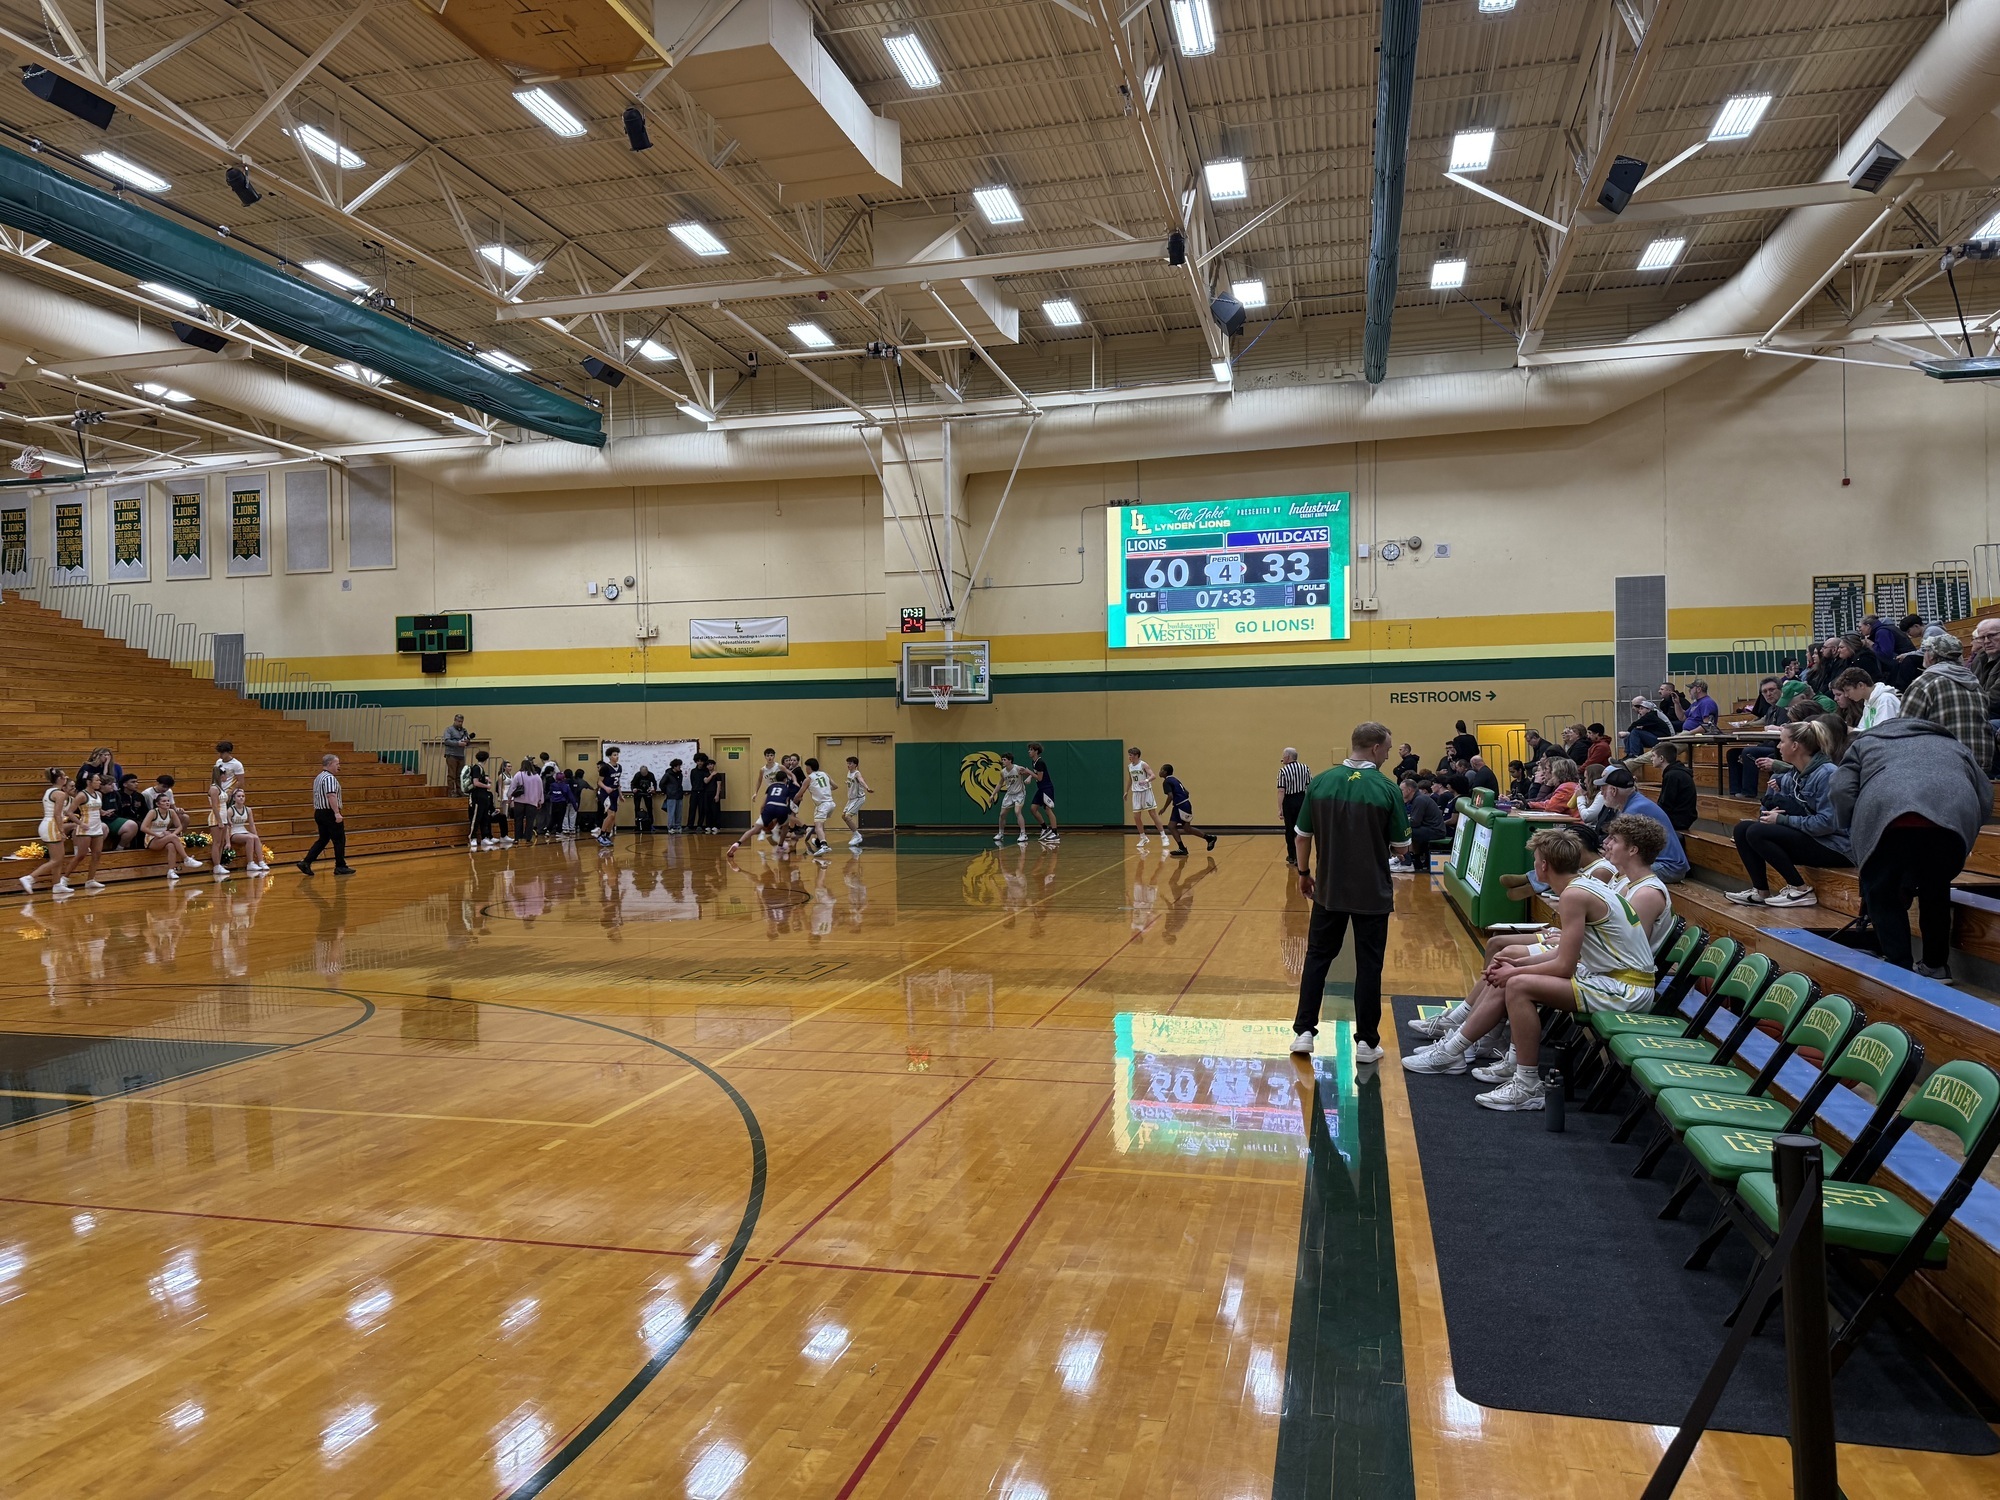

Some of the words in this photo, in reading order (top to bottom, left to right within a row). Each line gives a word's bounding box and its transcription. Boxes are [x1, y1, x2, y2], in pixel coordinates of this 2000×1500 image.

[173, 495, 200, 504] LYNDEN
[233, 494, 260, 503] LYNDEN
[114, 500, 140, 510] LYNDEN
[236, 506, 257, 515] LIONS
[1288, 500, 1341, 516] Industrial
[2, 512, 26, 521] LYNDEN
[56, 507, 82, 517] LYNDEN
[117, 512, 138, 521] LIONS
[176, 507, 197, 516] LIONS
[4, 523, 24, 532] LIONS
[60, 518, 79, 528] LIONS
[1154, 522, 1196, 532] LYNDEN
[1199, 520, 1230, 528] LIONS
[1257, 529, 1327, 544] WILDCATS
[1128, 539, 1167, 552] LIONS
[1212, 555, 1239, 563] PERIOD
[1144, 558, 1190, 588] 60
[1219, 564, 1231, 582] 4
[1262, 552, 1310, 583] 33
[1196, 589, 1255, 608] 07:33
[1306, 593, 1316, 605] 0
[1138, 600, 1148, 613] 0
[903, 608, 923, 618] 07:33
[904, 618, 922, 632] 24
[1194, 621, 1215, 630] supply
[1235, 621, 1258, 633] GO
[1262, 619, 1314, 632] LIONS!
[1141, 624, 1216, 641] WESTSIDE
[1390, 690, 1481, 704] RESTROOMS
[816, 776, 827, 788] 11
[770, 788, 782, 796] 13
[1732, 964, 1758, 990] LYNDEN
[1766, 984, 1797, 1012] LYNDEN
[1803, 1008, 1840, 1040] LYNDEN
[1848, 1036, 1893, 1076] LYNDEN
[1924, 1074, 1982, 1122] LYNDEN
